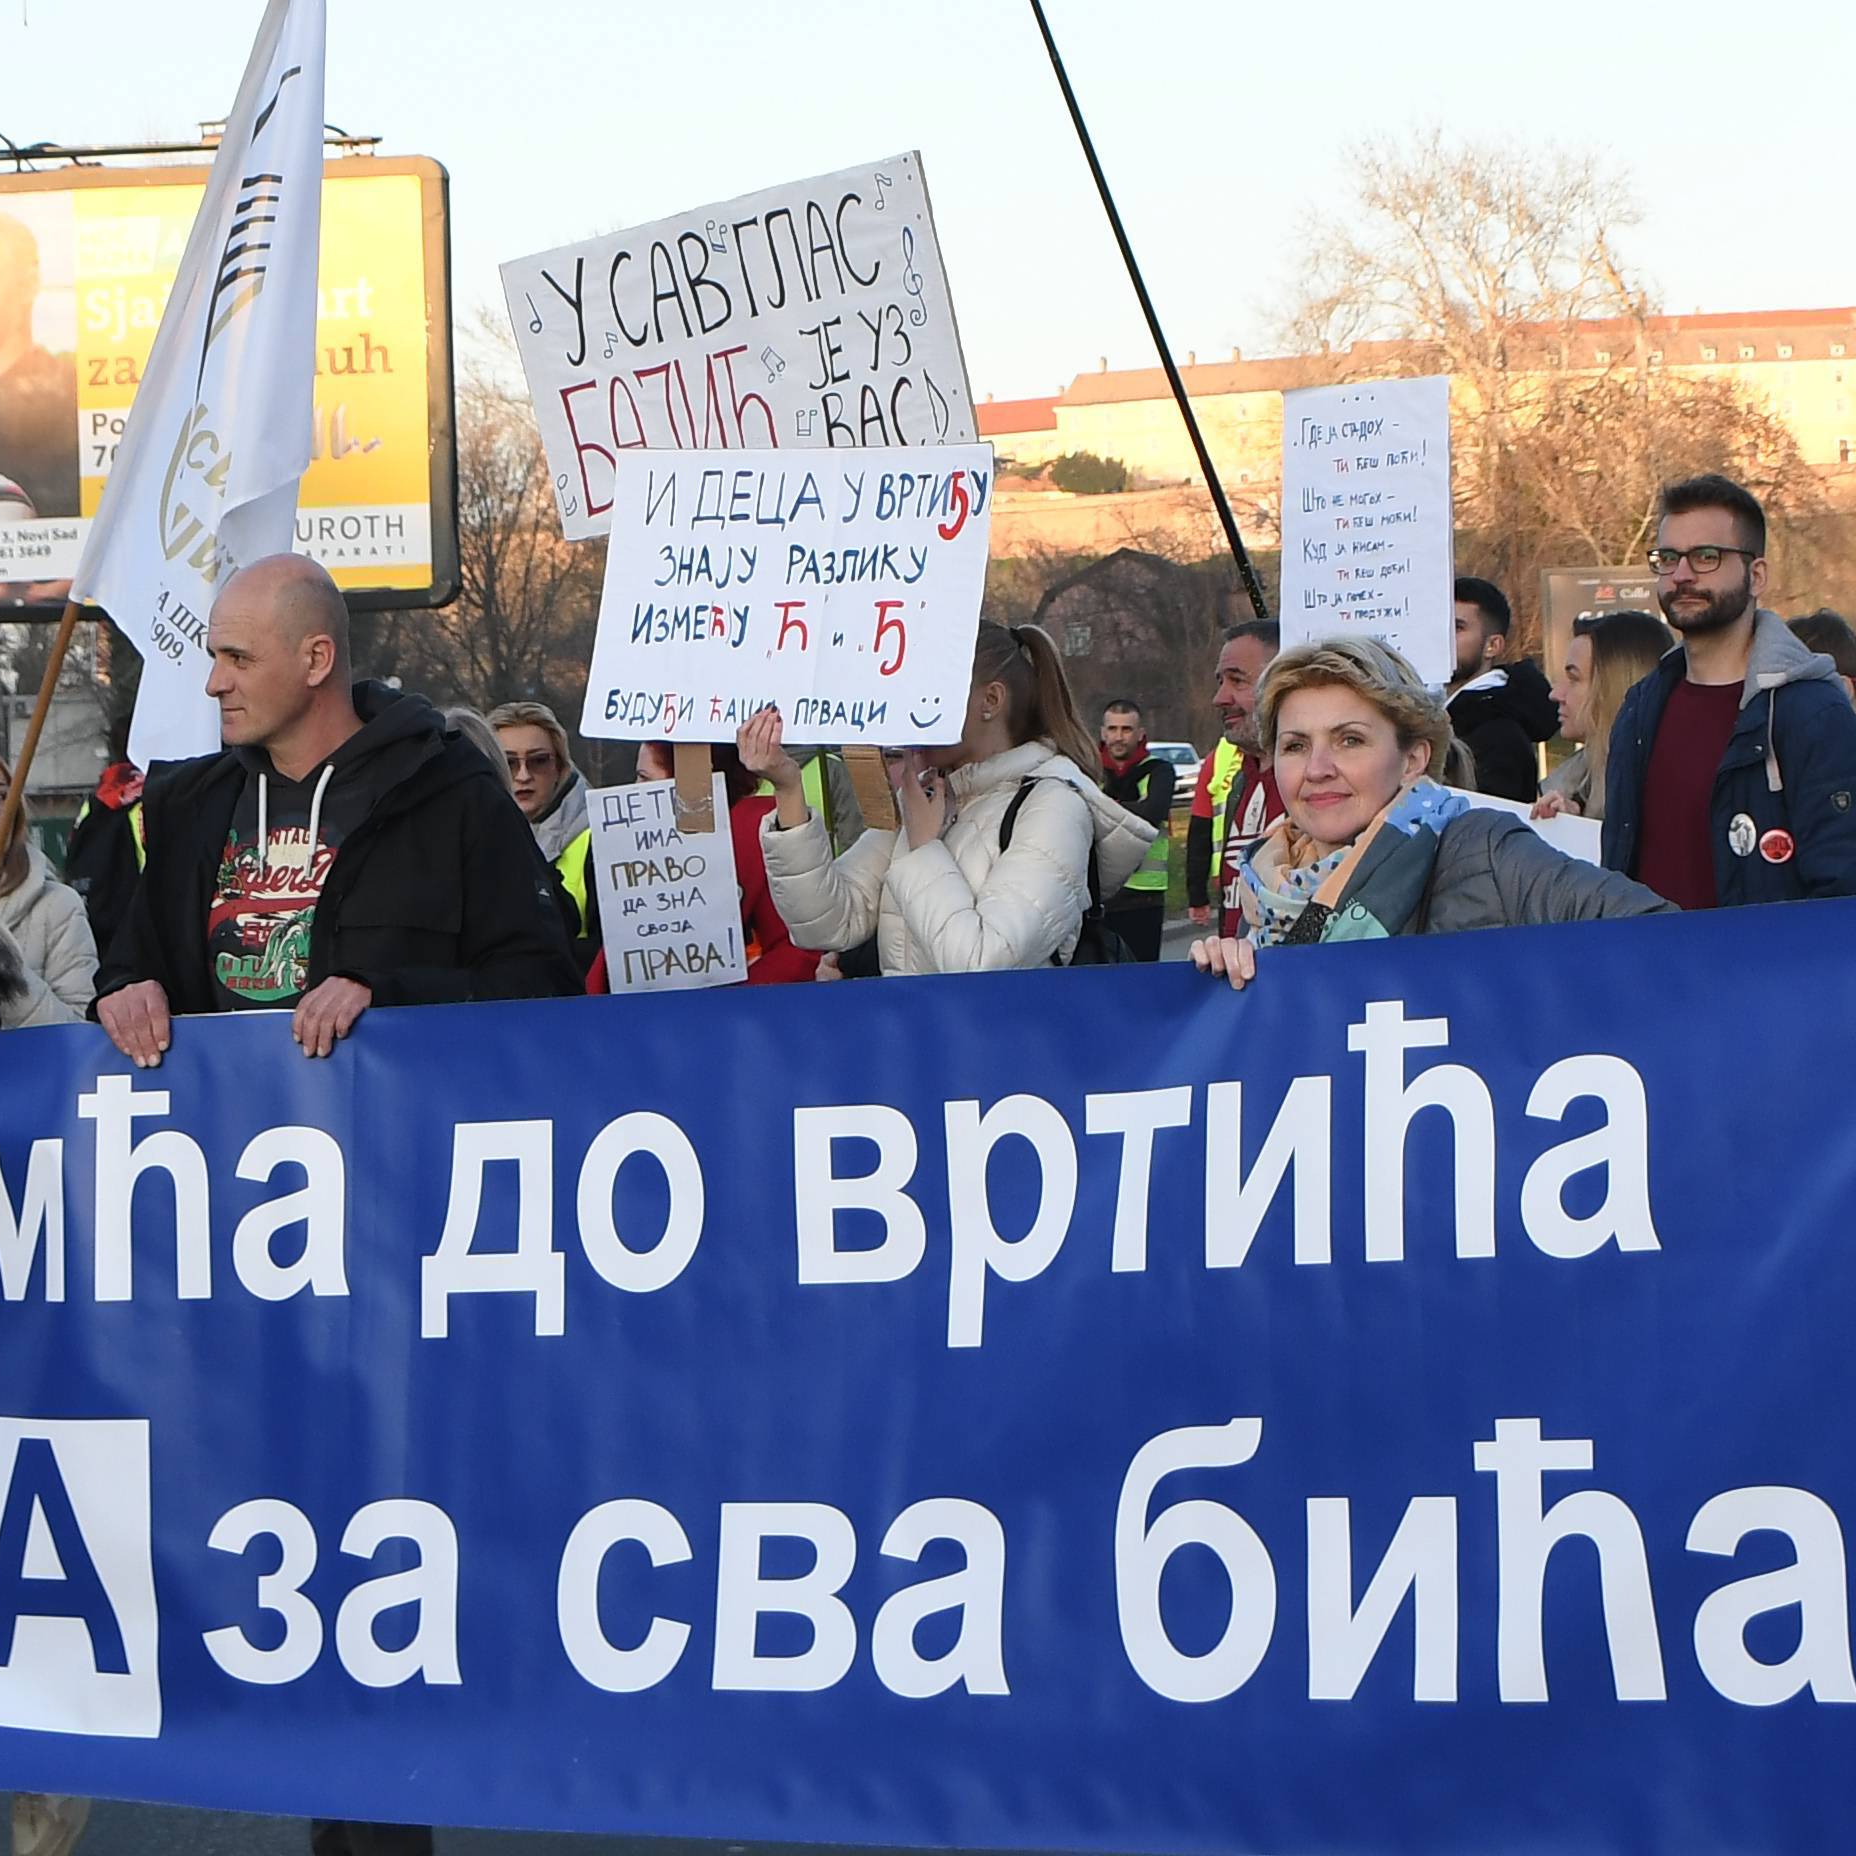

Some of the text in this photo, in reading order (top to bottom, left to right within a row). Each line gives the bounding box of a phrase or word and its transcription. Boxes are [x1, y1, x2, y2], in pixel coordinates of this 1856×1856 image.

[540, 192, 881, 367] У САВ ГЛАС
[798, 315, 851, 391] ЈЕ
[856, 303, 913, 372] УЗ
[88, 355, 140, 386] za
[645, 470, 676, 527] И
[690, 470, 826, 532] ДЕЦА
[841, 471, 865, 523] У
[52, 528, 78, 541] Sad
[295, 514, 406, 542] UROTH
[654, 543, 928, 590] ЗНАЈУ РАЗЛИКУ
[604, 688, 694, 734] БУДУЂИ
[794, 697, 887, 732] ПРВАЦИ
[602, 786, 676, 832] ДЕТ
[635, 828, 684, 852] ИМА
[611, 855, 706, 891] ПРАВО
[623, 887, 706, 916] ДА ЗНА
[624, 927, 736, 984] ПРАВА!
[418, 1108, 706, 1339] до
[793, 998, 1662, 1348] вртића
[202, 1497, 462, 1690] за
[557, 1496, 1011, 1700] сва
